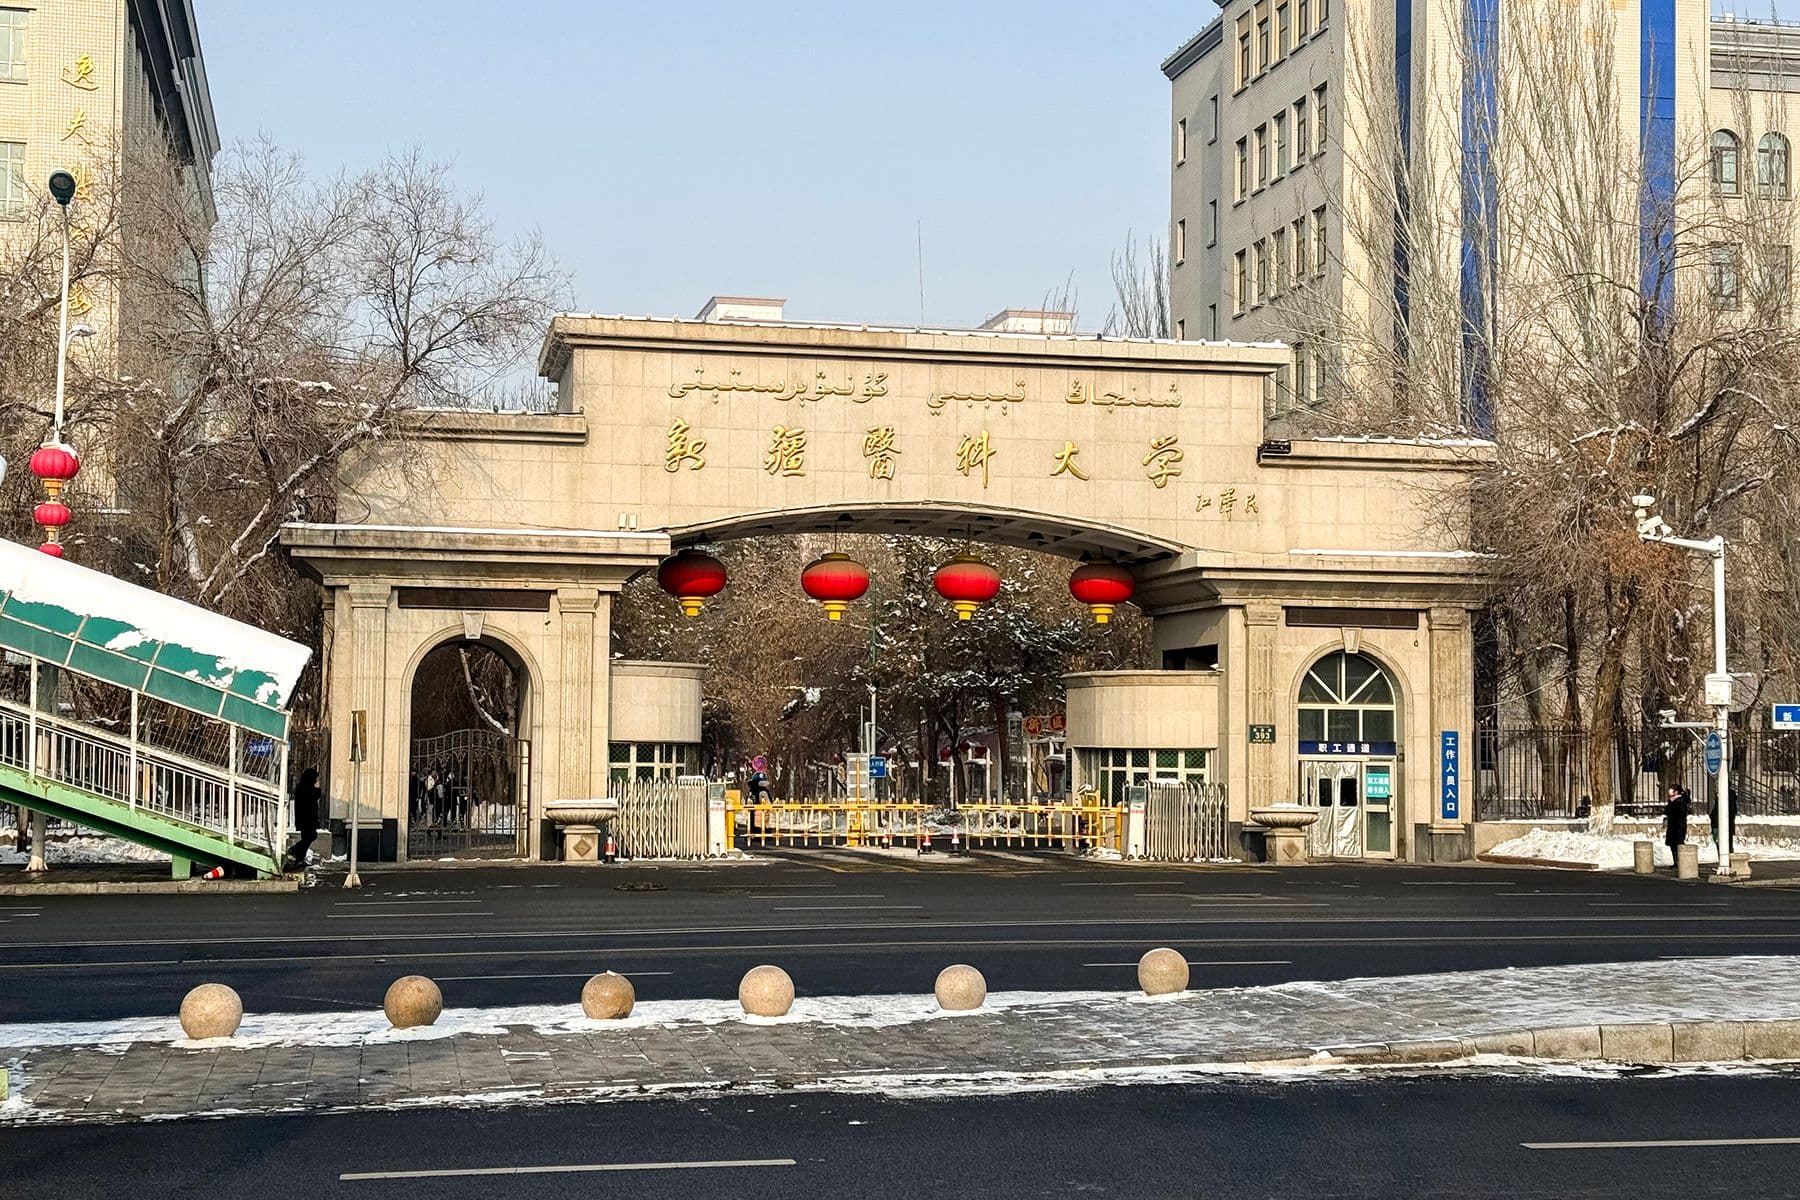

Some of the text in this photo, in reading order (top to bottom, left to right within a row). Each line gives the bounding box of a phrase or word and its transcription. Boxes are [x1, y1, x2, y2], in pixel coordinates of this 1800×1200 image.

[1254, 732, 1270, 740] 393
[1318, 743, 1370, 753] 职工通道
[1445, 737, 1456, 811] 工作人员入口
